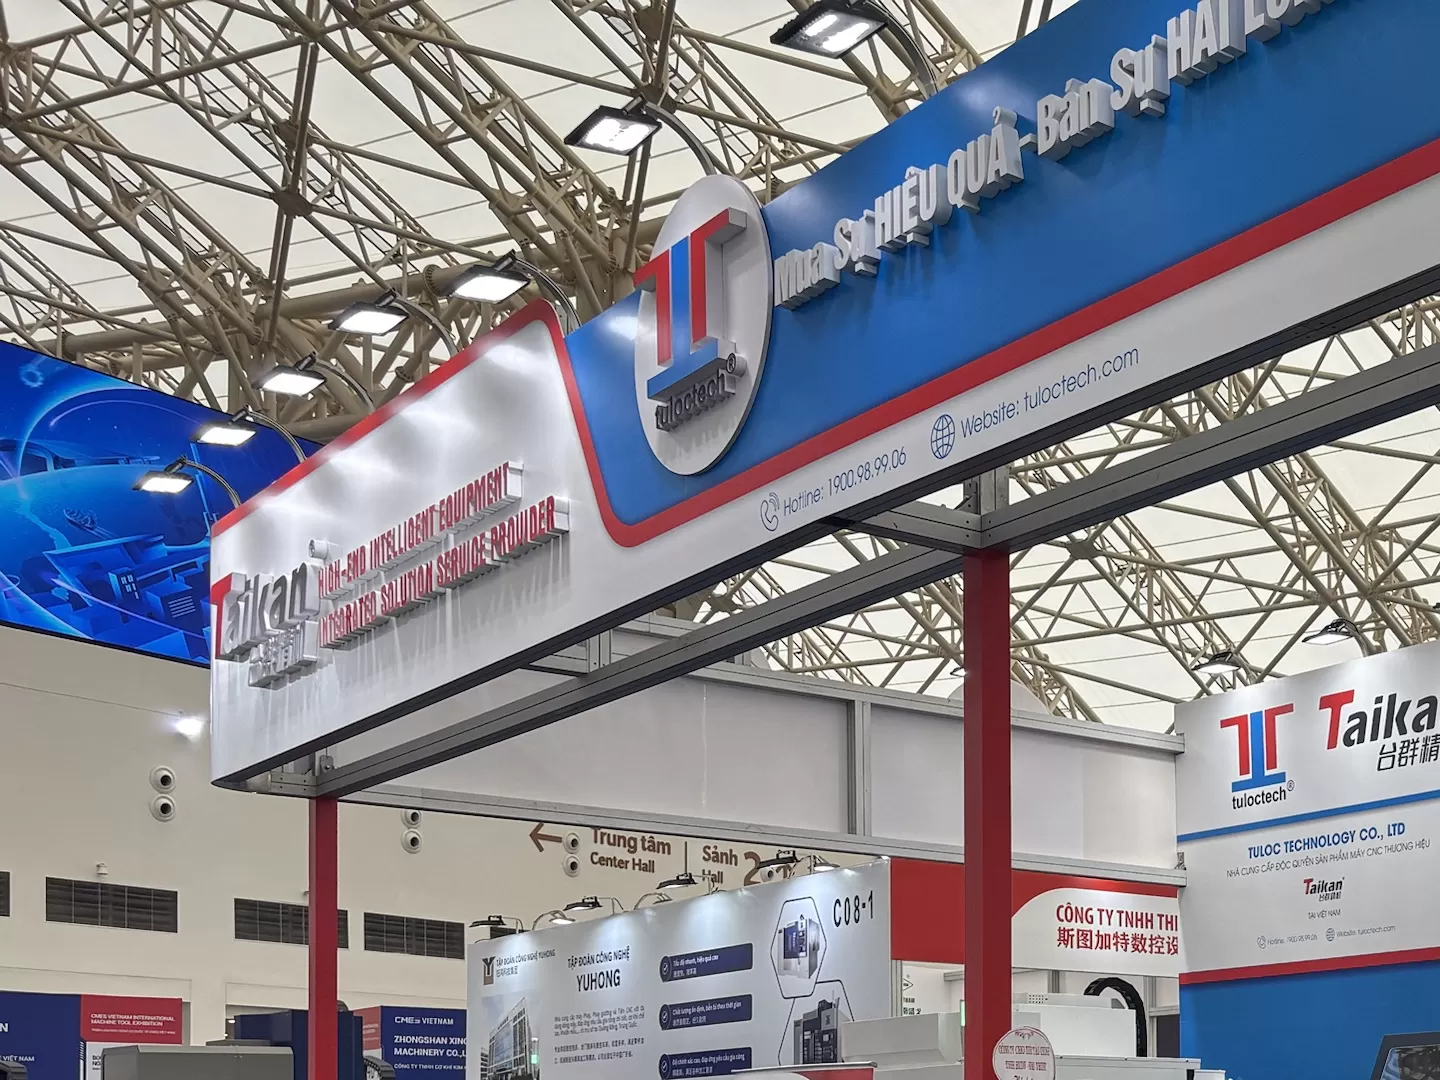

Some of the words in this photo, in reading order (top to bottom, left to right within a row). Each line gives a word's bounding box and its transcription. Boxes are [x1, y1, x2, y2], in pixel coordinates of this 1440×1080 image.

[774, 243, 838, 308] Mua
[834, 210, 880, 275] Sự
[874, 165, 952, 253] HIỆU
[947, 105, 1024, 214] QUẢ
[1110, 34, 1170, 117] Sự
[784, 487, 824, 517] Hotline:
[828, 446, 906, 495] 1900.98.99.06
[961, 401, 1019, 438] Website:
[1025, 348, 1139, 412] tuloctech.com
[319, 545, 366, 599] HIGH-END
[370, 509, 435, 570] INTELLIGENT
[439, 462, 509, 531] EQUIPMENT
[320, 592, 377, 648] INTEGRATED
[381, 560, 434, 615] SOLUTION
[437, 533, 487, 587] SERVICE
[490, 496, 556, 556] PROVIDER
[591, 828, 638, 853] Trung
[640, 833, 671, 855] tâm
[1248, 844, 1281, 859] TULOC
[1284, 831, 1356, 853] TECHNOLOGY
[1359, 827, 1384, 841] CO.,
[1387, 822, 1405, 837] LTD
[591, 853, 629, 871] Center
[633, 859, 655, 873] Hall
[702, 844, 738, 866] Sảnh
[1241, 866, 1260, 876] CUNG
[1350, 849, 1365, 860] MÁY
[1367, 846, 1383, 857] CNC
[833, 890, 874, 927] C08-1
[1057, 902, 1094, 925] CÔNG
[1097, 908, 1113, 926] TY
[1116, 910, 1154, 930] TNHH
[568, 956, 578, 970] TẬP
[579, 953, 595, 966] ĐOÀN
[596, 951, 612, 964] CÔNG
[614, 946, 630, 961] NGHỆ
[577, 969, 621, 992] YUHONG
[422, 1017, 454, 1025] VIETNAM
[394, 1035, 447, 1044] ZHONGSHAN
[394, 1048, 444, 1056] MACHINERY
